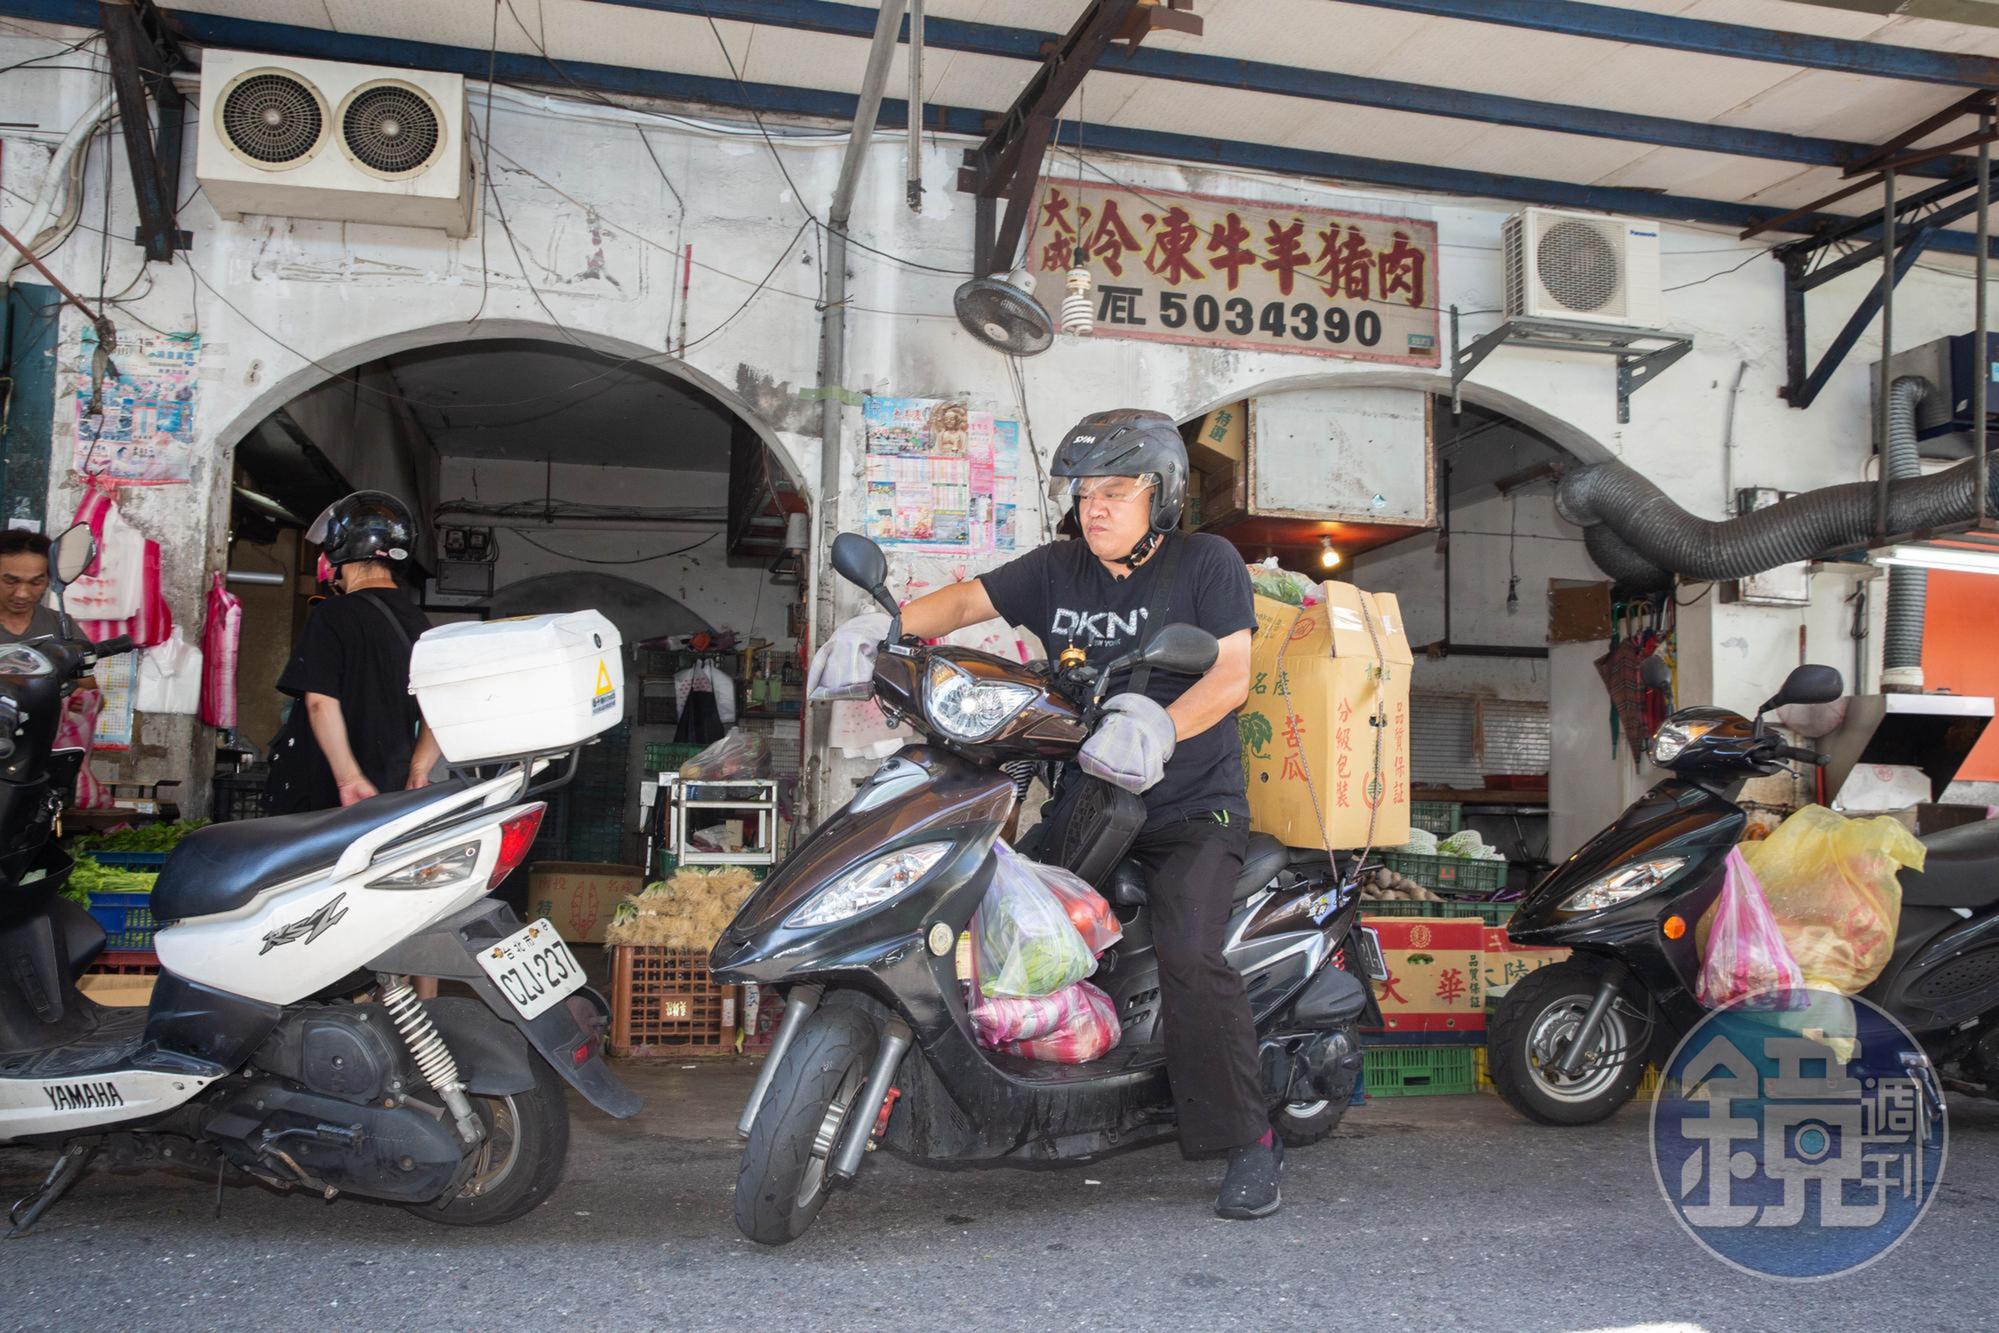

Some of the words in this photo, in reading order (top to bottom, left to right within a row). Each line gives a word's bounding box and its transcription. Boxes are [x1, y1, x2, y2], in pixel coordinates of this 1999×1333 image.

[1097, 284, 1147, 326] TEL
[1159, 291, 1382, 347] 5034390
[1051, 607, 1149, 639] DKN
[1281, 714, 1309, 782] 苦瓜
[503, 935, 536, 961] 台北市
[43, 1082, 124, 1111] YAMAHA
